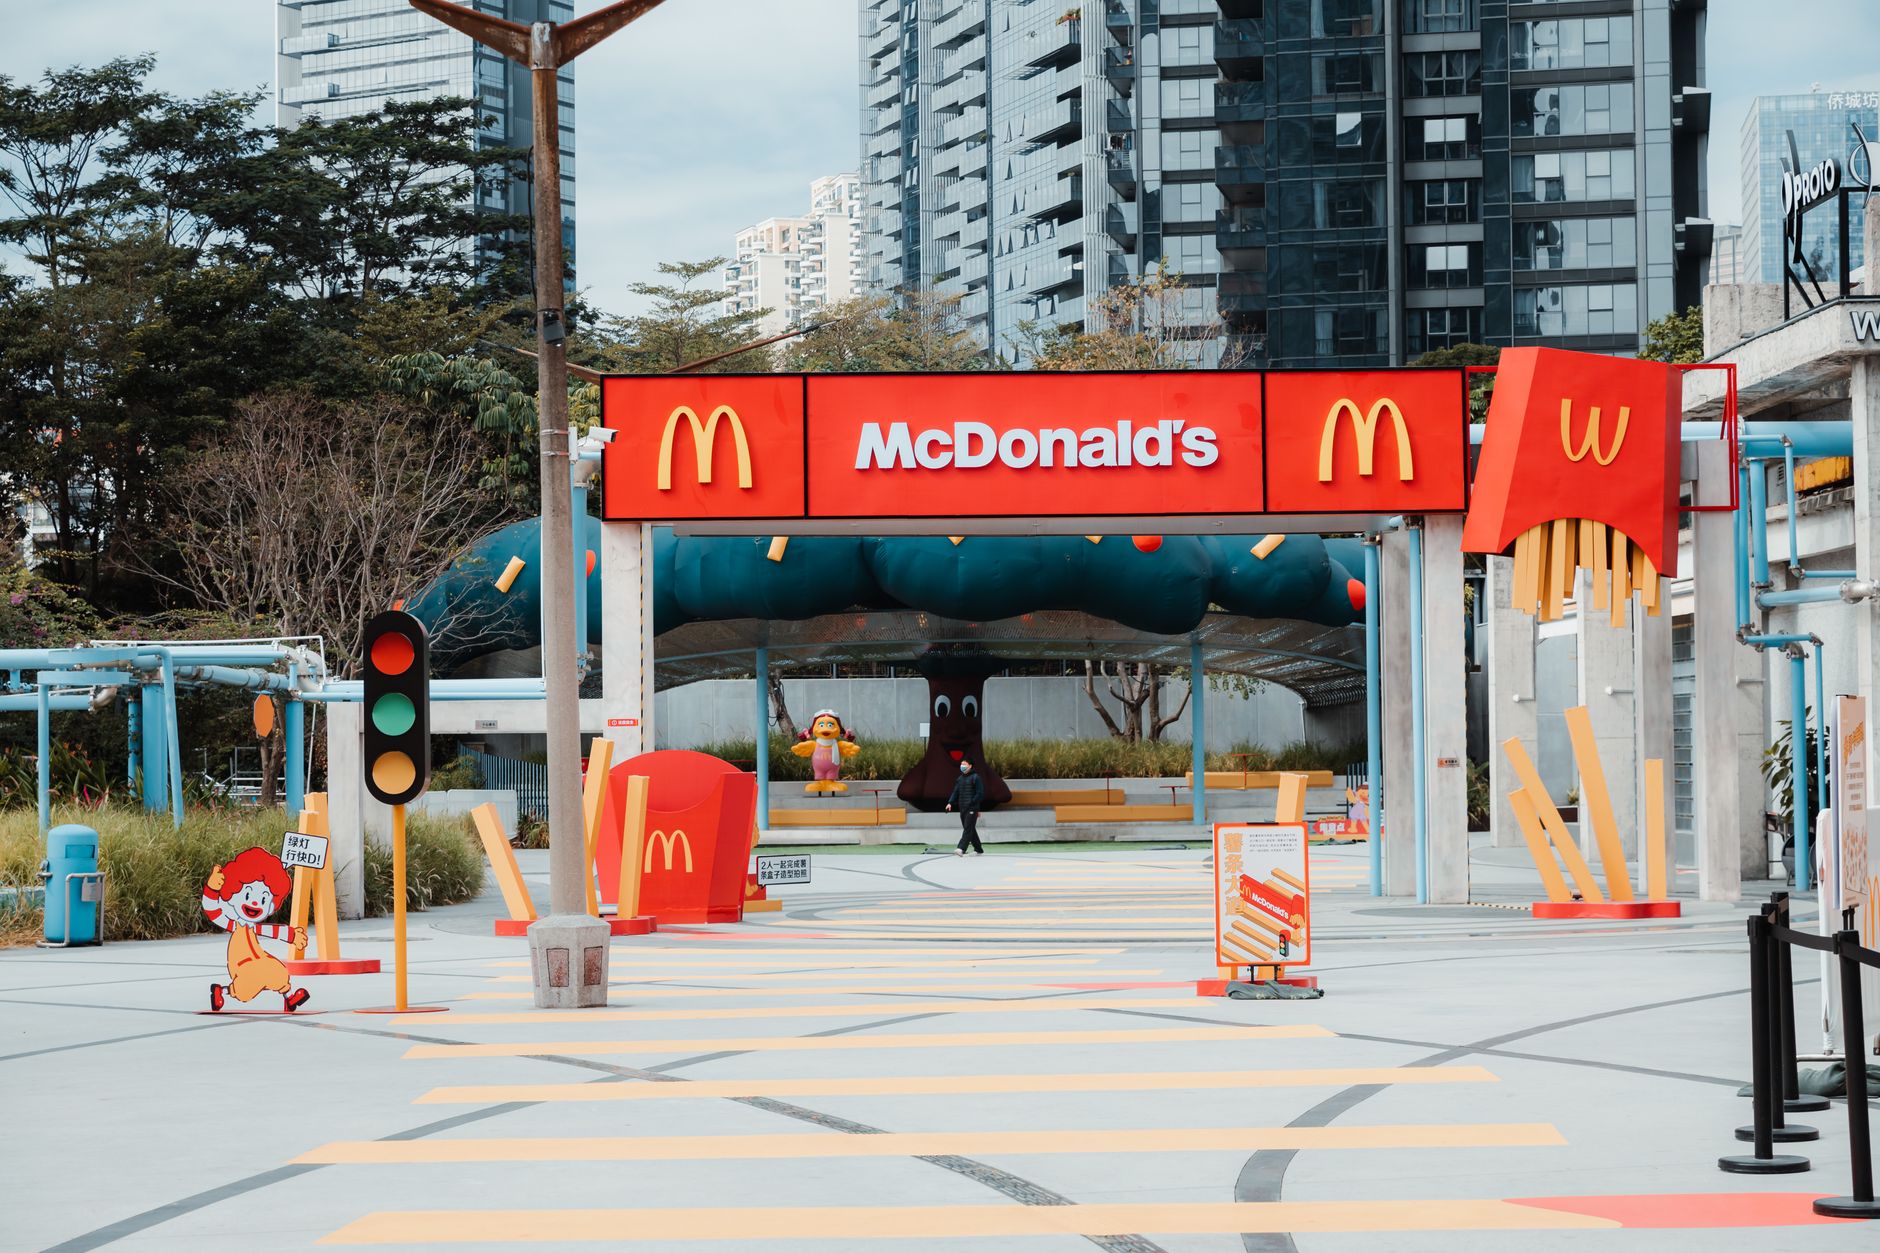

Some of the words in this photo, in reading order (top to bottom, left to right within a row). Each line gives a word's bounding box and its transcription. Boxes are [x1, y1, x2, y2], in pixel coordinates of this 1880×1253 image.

[1828, 93, 1879, 110] 侨城坊
[1793, 158, 1835, 210] PROTO
[855, 420, 1218, 468] McDonald's
[288, 835, 310, 850] 绿灯
[286, 849, 321, 865] 行快D!
